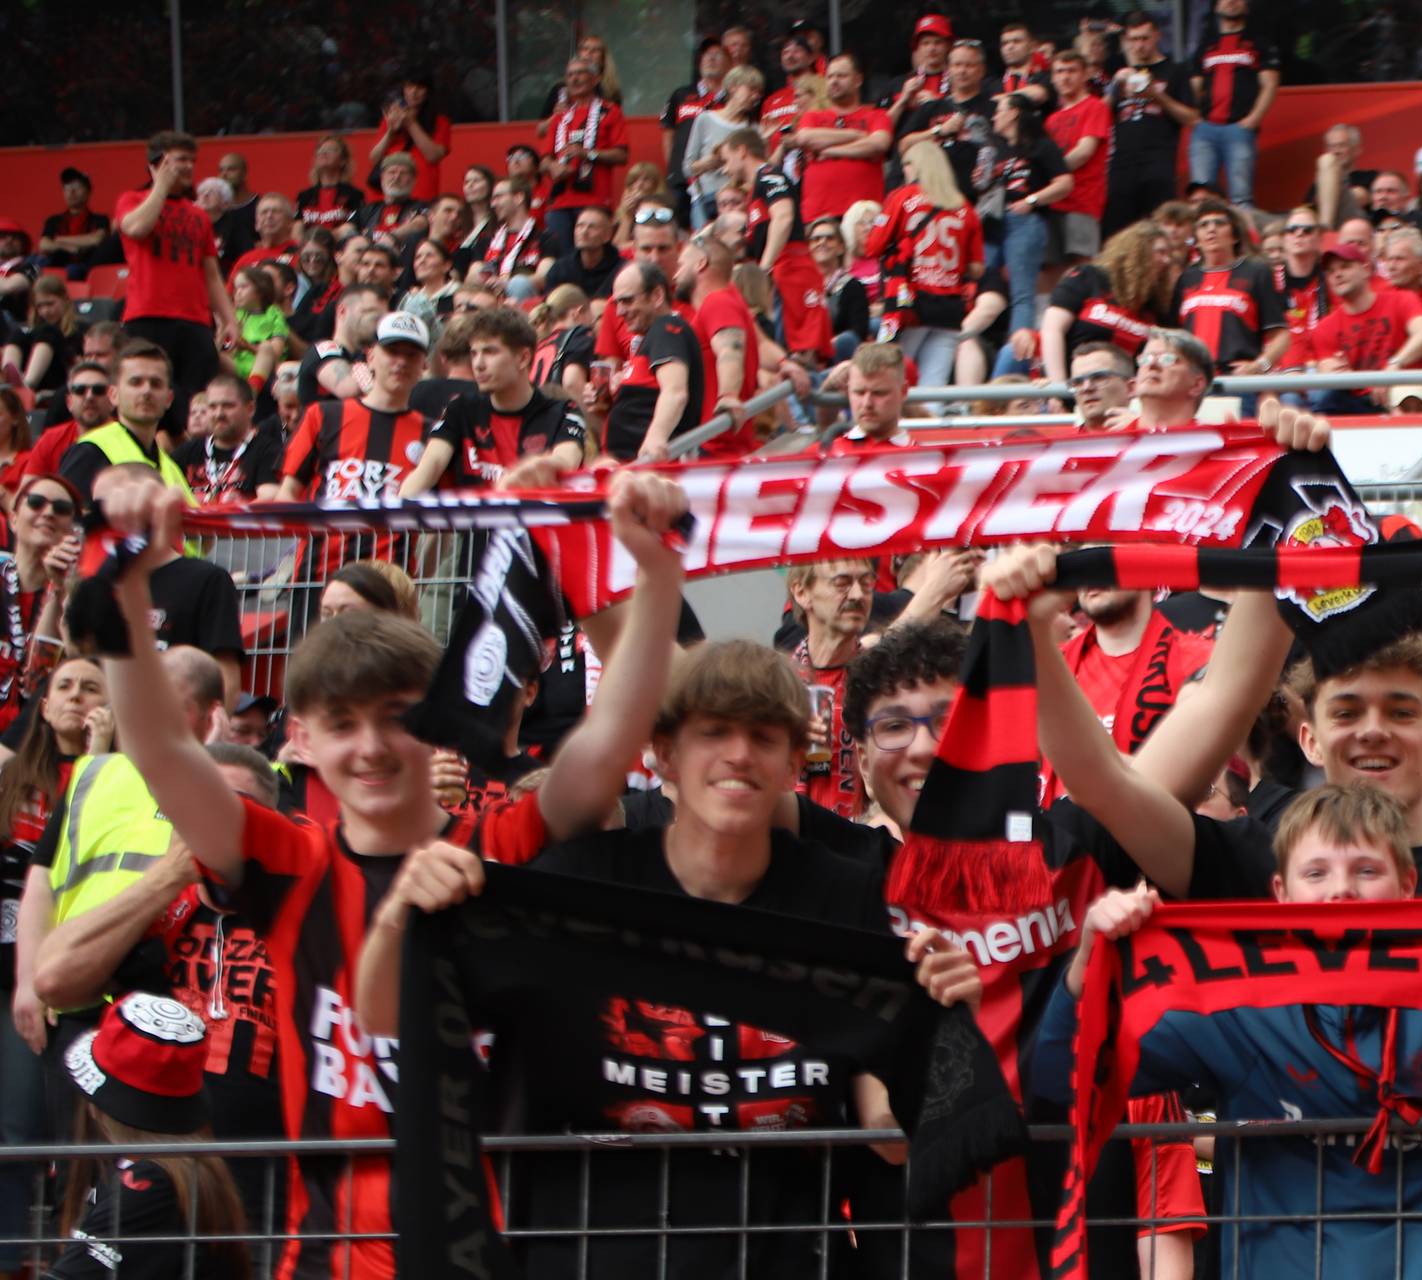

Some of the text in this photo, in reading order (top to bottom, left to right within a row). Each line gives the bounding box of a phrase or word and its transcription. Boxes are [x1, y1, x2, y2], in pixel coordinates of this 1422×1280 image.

[327, 458, 403, 484] FORZ
[1158, 500, 1244, 541] 2024
[174, 936, 273, 963] ORZA
[888, 899, 1077, 967] menia
[602, 1058, 830, 1096] MEISTER
